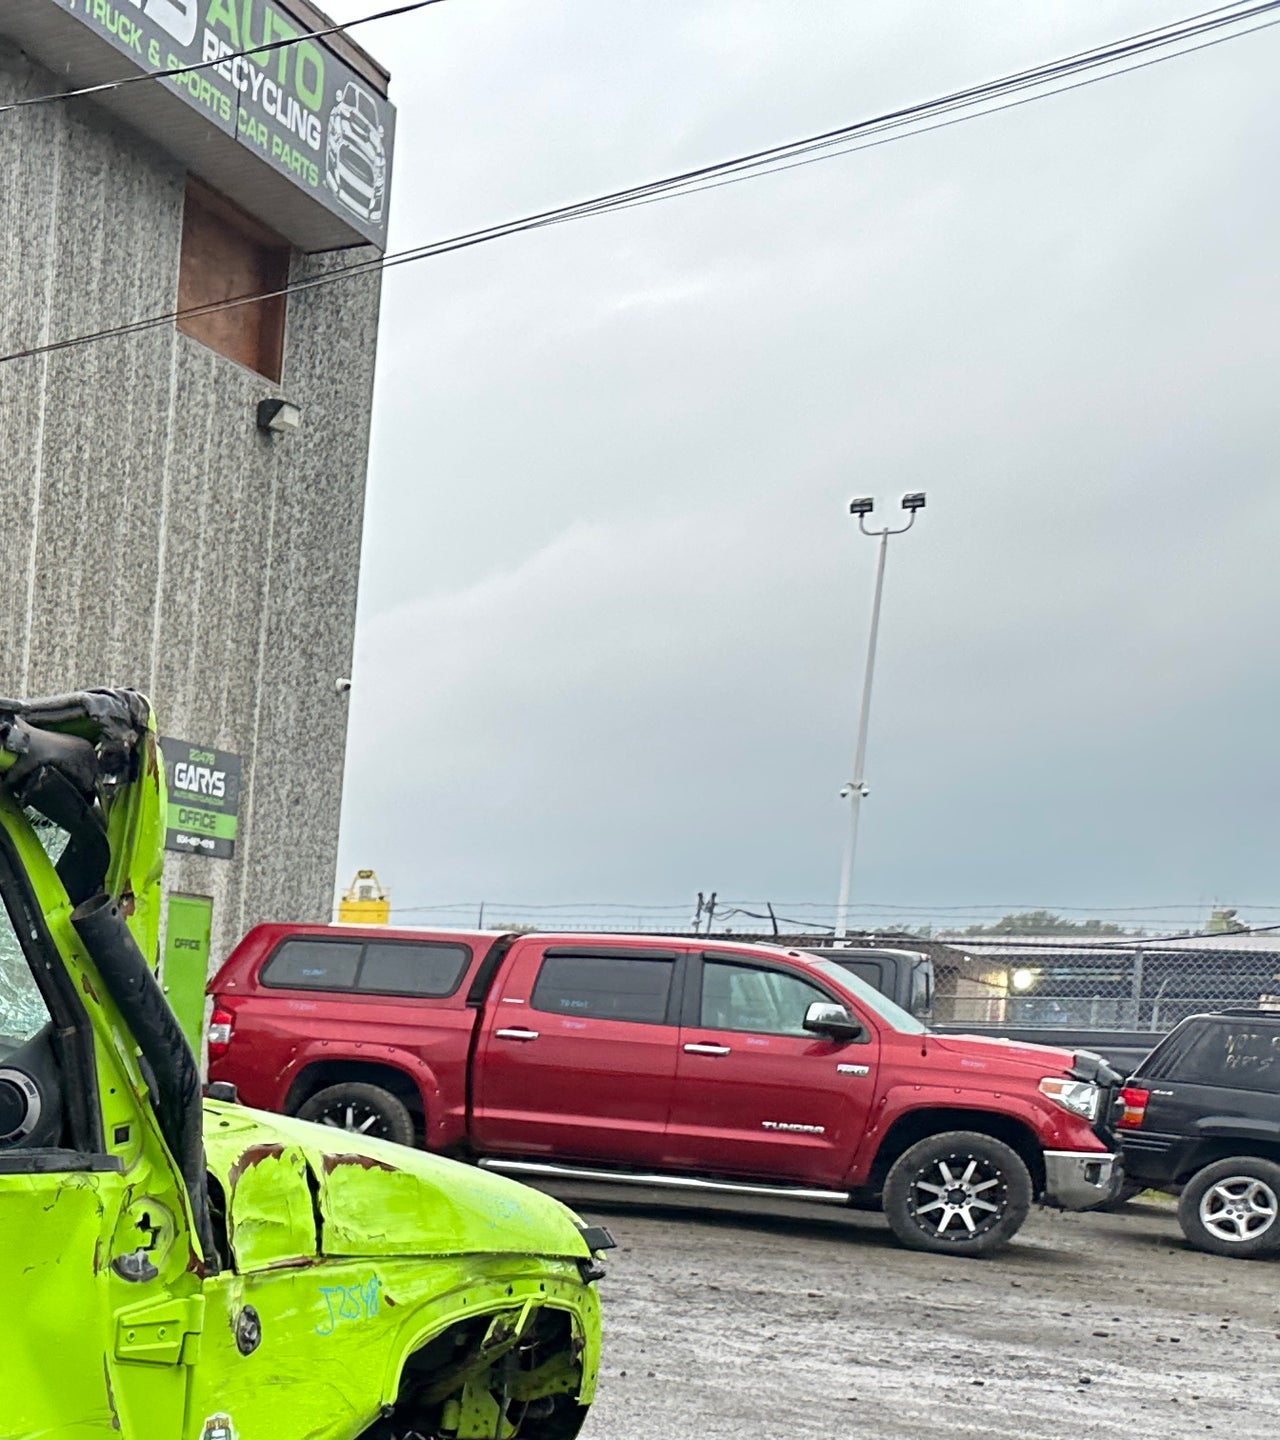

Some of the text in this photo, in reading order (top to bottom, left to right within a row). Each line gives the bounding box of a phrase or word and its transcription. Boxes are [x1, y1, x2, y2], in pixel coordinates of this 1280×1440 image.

[206, 0, 325, 112] AUTO
[148, 38, 161, 68] &
[167, 52, 231, 121] SPORTS
[238, 106, 269, 150] CAR
[271, 135, 320, 188] PARTS
[202, 28, 322, 151] RECYCLING
[175, 762, 225, 797] GARYS
[179, 808, 216, 830] OFFICE
[761, 1121, 825, 1133] TUNDRA
[315, 1277, 380, 1336] J2548
